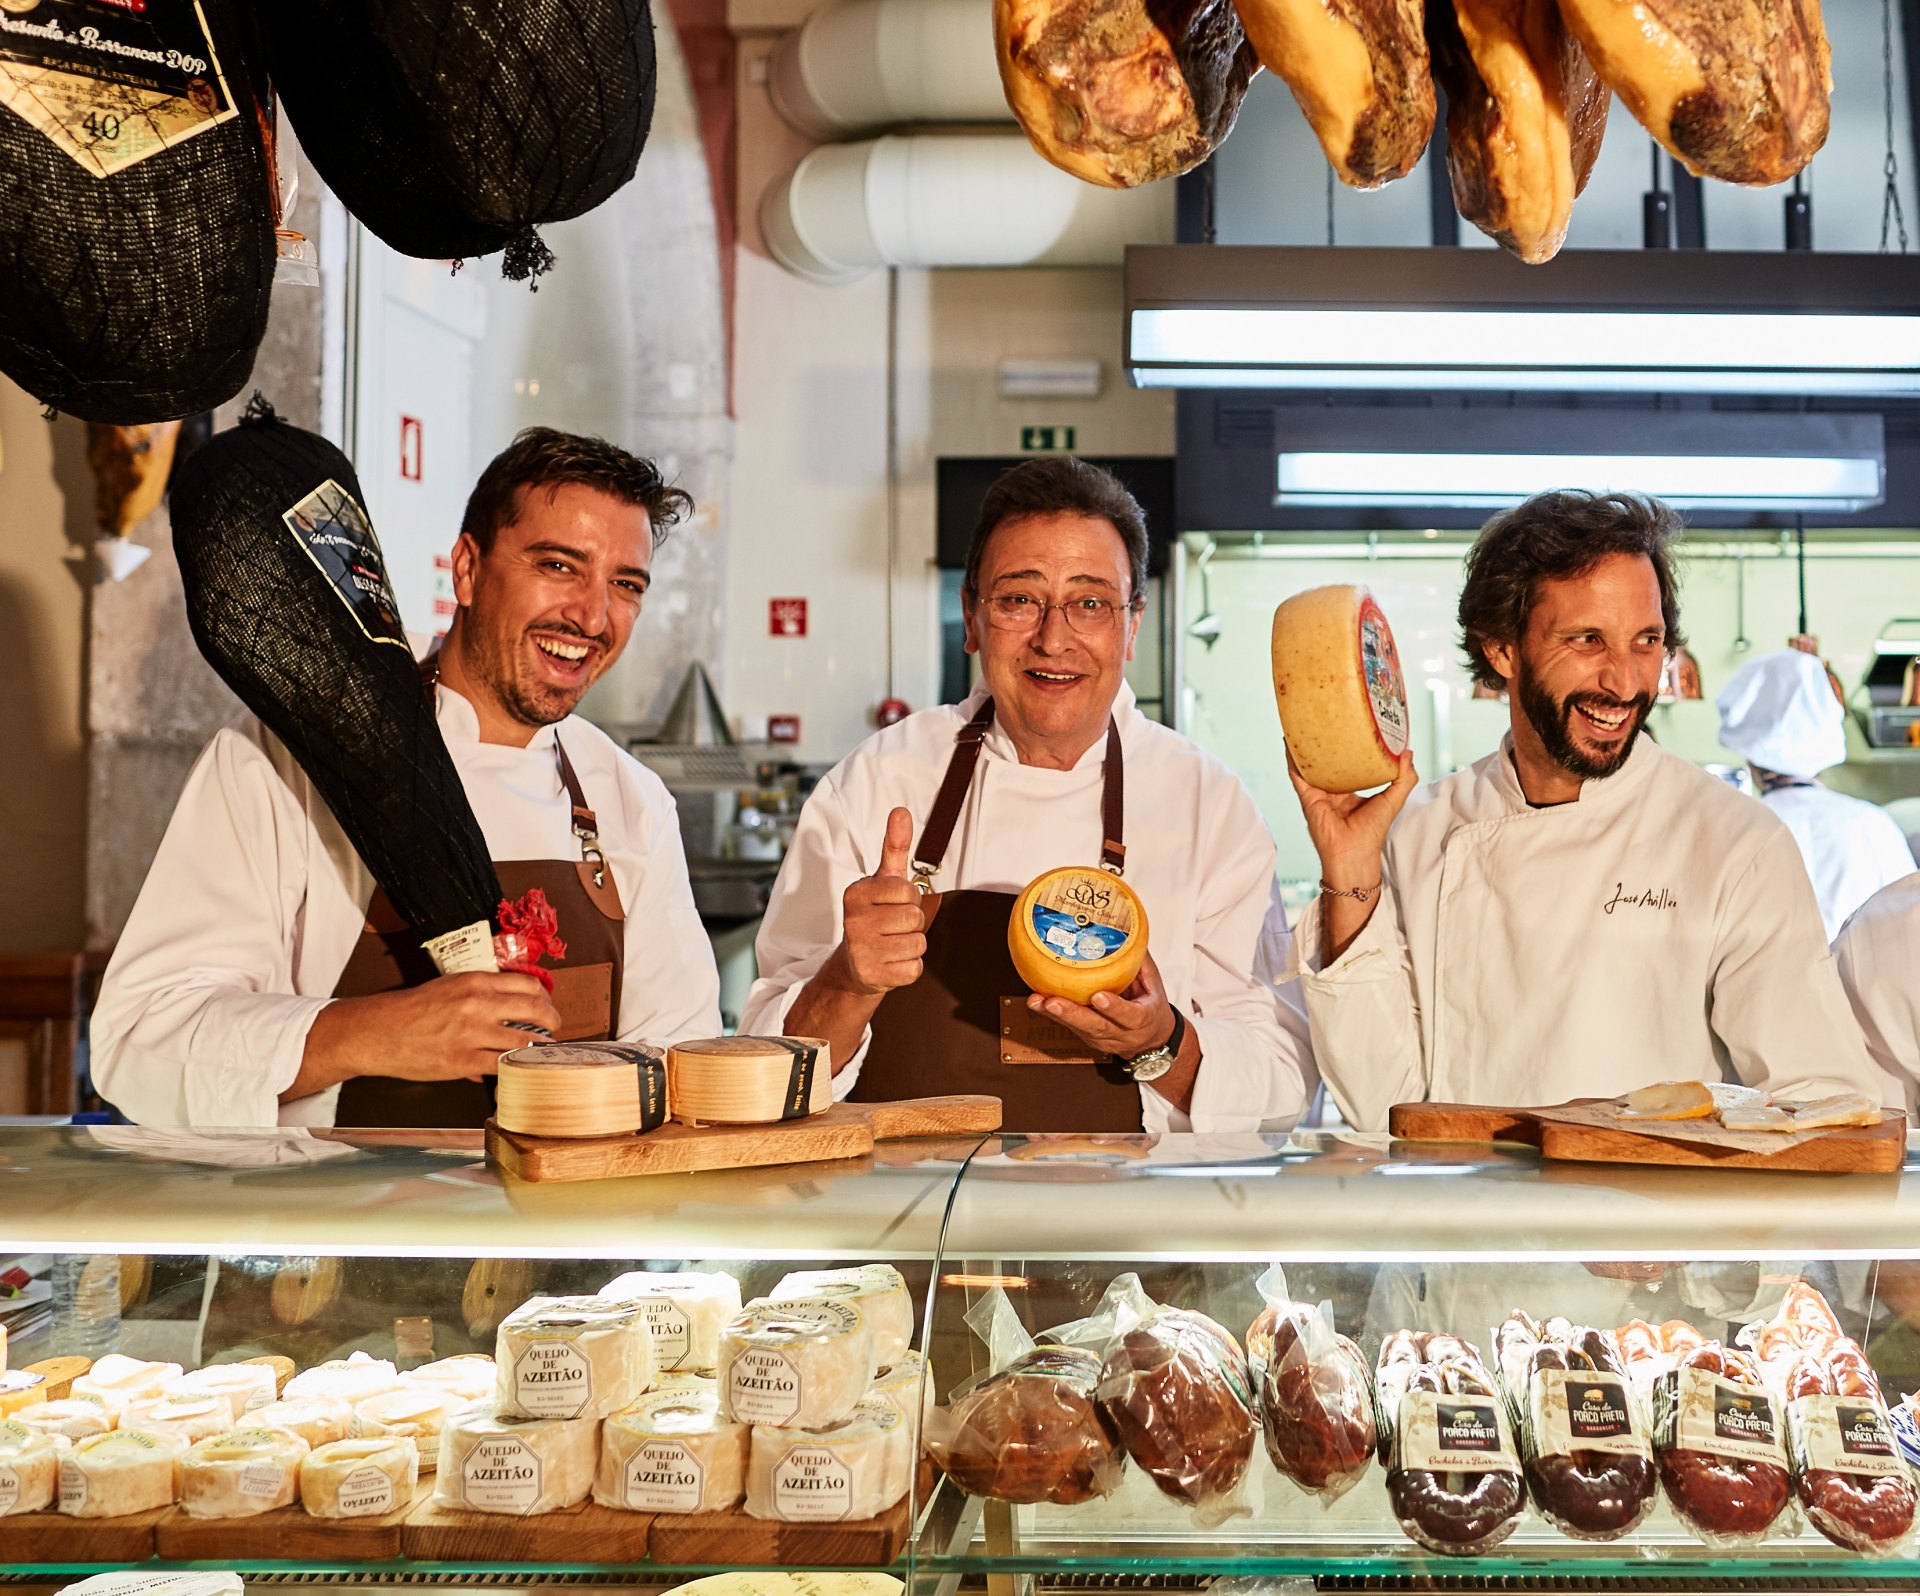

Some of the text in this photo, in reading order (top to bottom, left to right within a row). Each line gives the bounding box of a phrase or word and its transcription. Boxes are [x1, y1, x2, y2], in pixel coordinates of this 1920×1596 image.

[166, 49, 207, 76] DOP
[82, 111, 120, 141] 40
[529, 1348, 570, 1361] QUEIJO
[542, 1360, 557, 1370] DE
[744, 1354, 784, 1368] QUEIJO
[522, 1368, 583, 1384] AZEITÃO
[756, 1367, 770, 1377] DE
[735, 1375, 794, 1392] AZEITÃO
[1582, 1401, 1601, 1410] Casa
[1573, 1409, 1625, 1423] PORCO PRETO
[1729, 1407, 1747, 1419] Casa
[1718, 1412, 1771, 1432] PORCO PRETO
[1854, 1423, 1873, 1432] Casa
[1442, 1427, 1496, 1439] PORCO PRETO
[1845, 1430, 1872, 1442] PORCO
[479, 1446, 522, 1457] QUEIJO
[643, 1449, 684, 1461] QUEIJO
[493, 1457, 508, 1467] DE
[656, 1461, 671, 1471] DE
[790, 1455, 832, 1467] QUEIJO
[470, 1466, 534, 1480] AZEITÃO
[804, 1467, 819, 1476] DE
[633, 1471, 695, 1485] AZEITÃO
[781, 1476, 845, 1490] AZEITÃO
